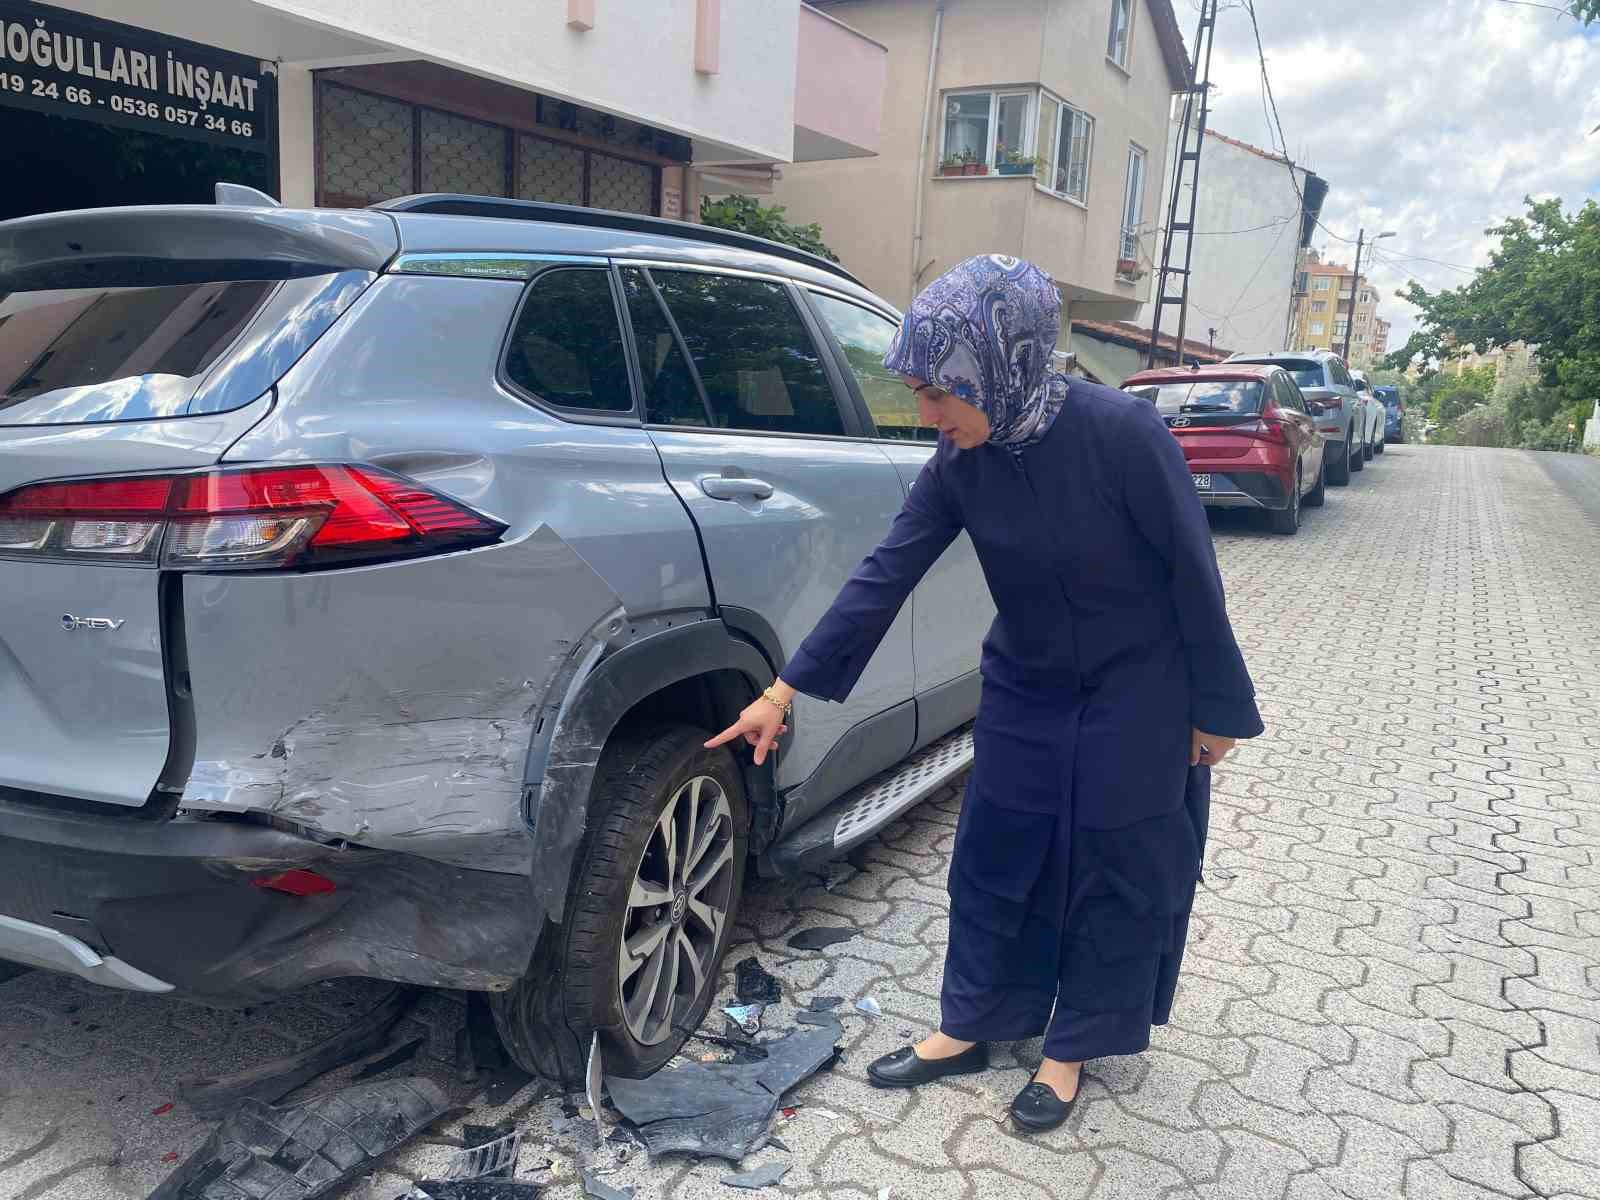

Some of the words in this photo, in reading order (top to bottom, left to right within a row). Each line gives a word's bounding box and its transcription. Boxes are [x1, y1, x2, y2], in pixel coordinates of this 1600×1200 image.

[32, 79, 59, 99] 24
[65, 85, 92, 105] 66
[110, 95, 159, 119] 0536
[165, 106, 198, 126] 057
[204, 114, 226, 132] 34
[231, 120, 253, 137] 66
[167, 50, 258, 112] İNŞAAT
